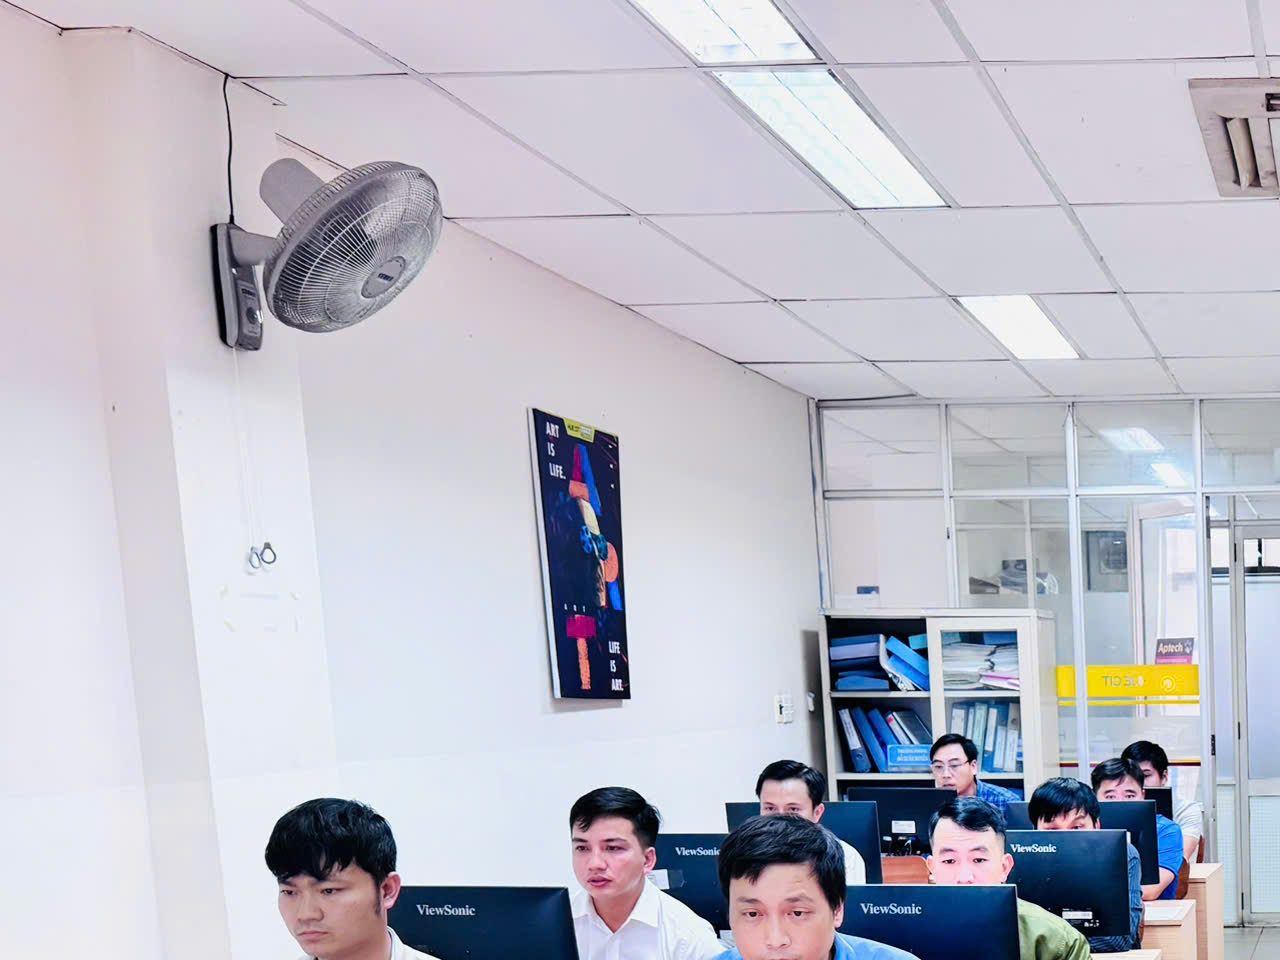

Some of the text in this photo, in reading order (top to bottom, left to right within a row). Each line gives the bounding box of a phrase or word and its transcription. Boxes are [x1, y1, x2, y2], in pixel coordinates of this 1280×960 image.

[546, 421, 559, 438] ART
[547, 442, 555, 456] IS
[608, 640, 621, 654] LIFE
[1158, 642, 1184, 655] Aptech
[610, 659, 617, 672] IS
[1010, 843, 1057, 853] ViewSonic
[416, 904, 476, 916] ViewSonic
[860, 902, 922, 914] ViewSonic
